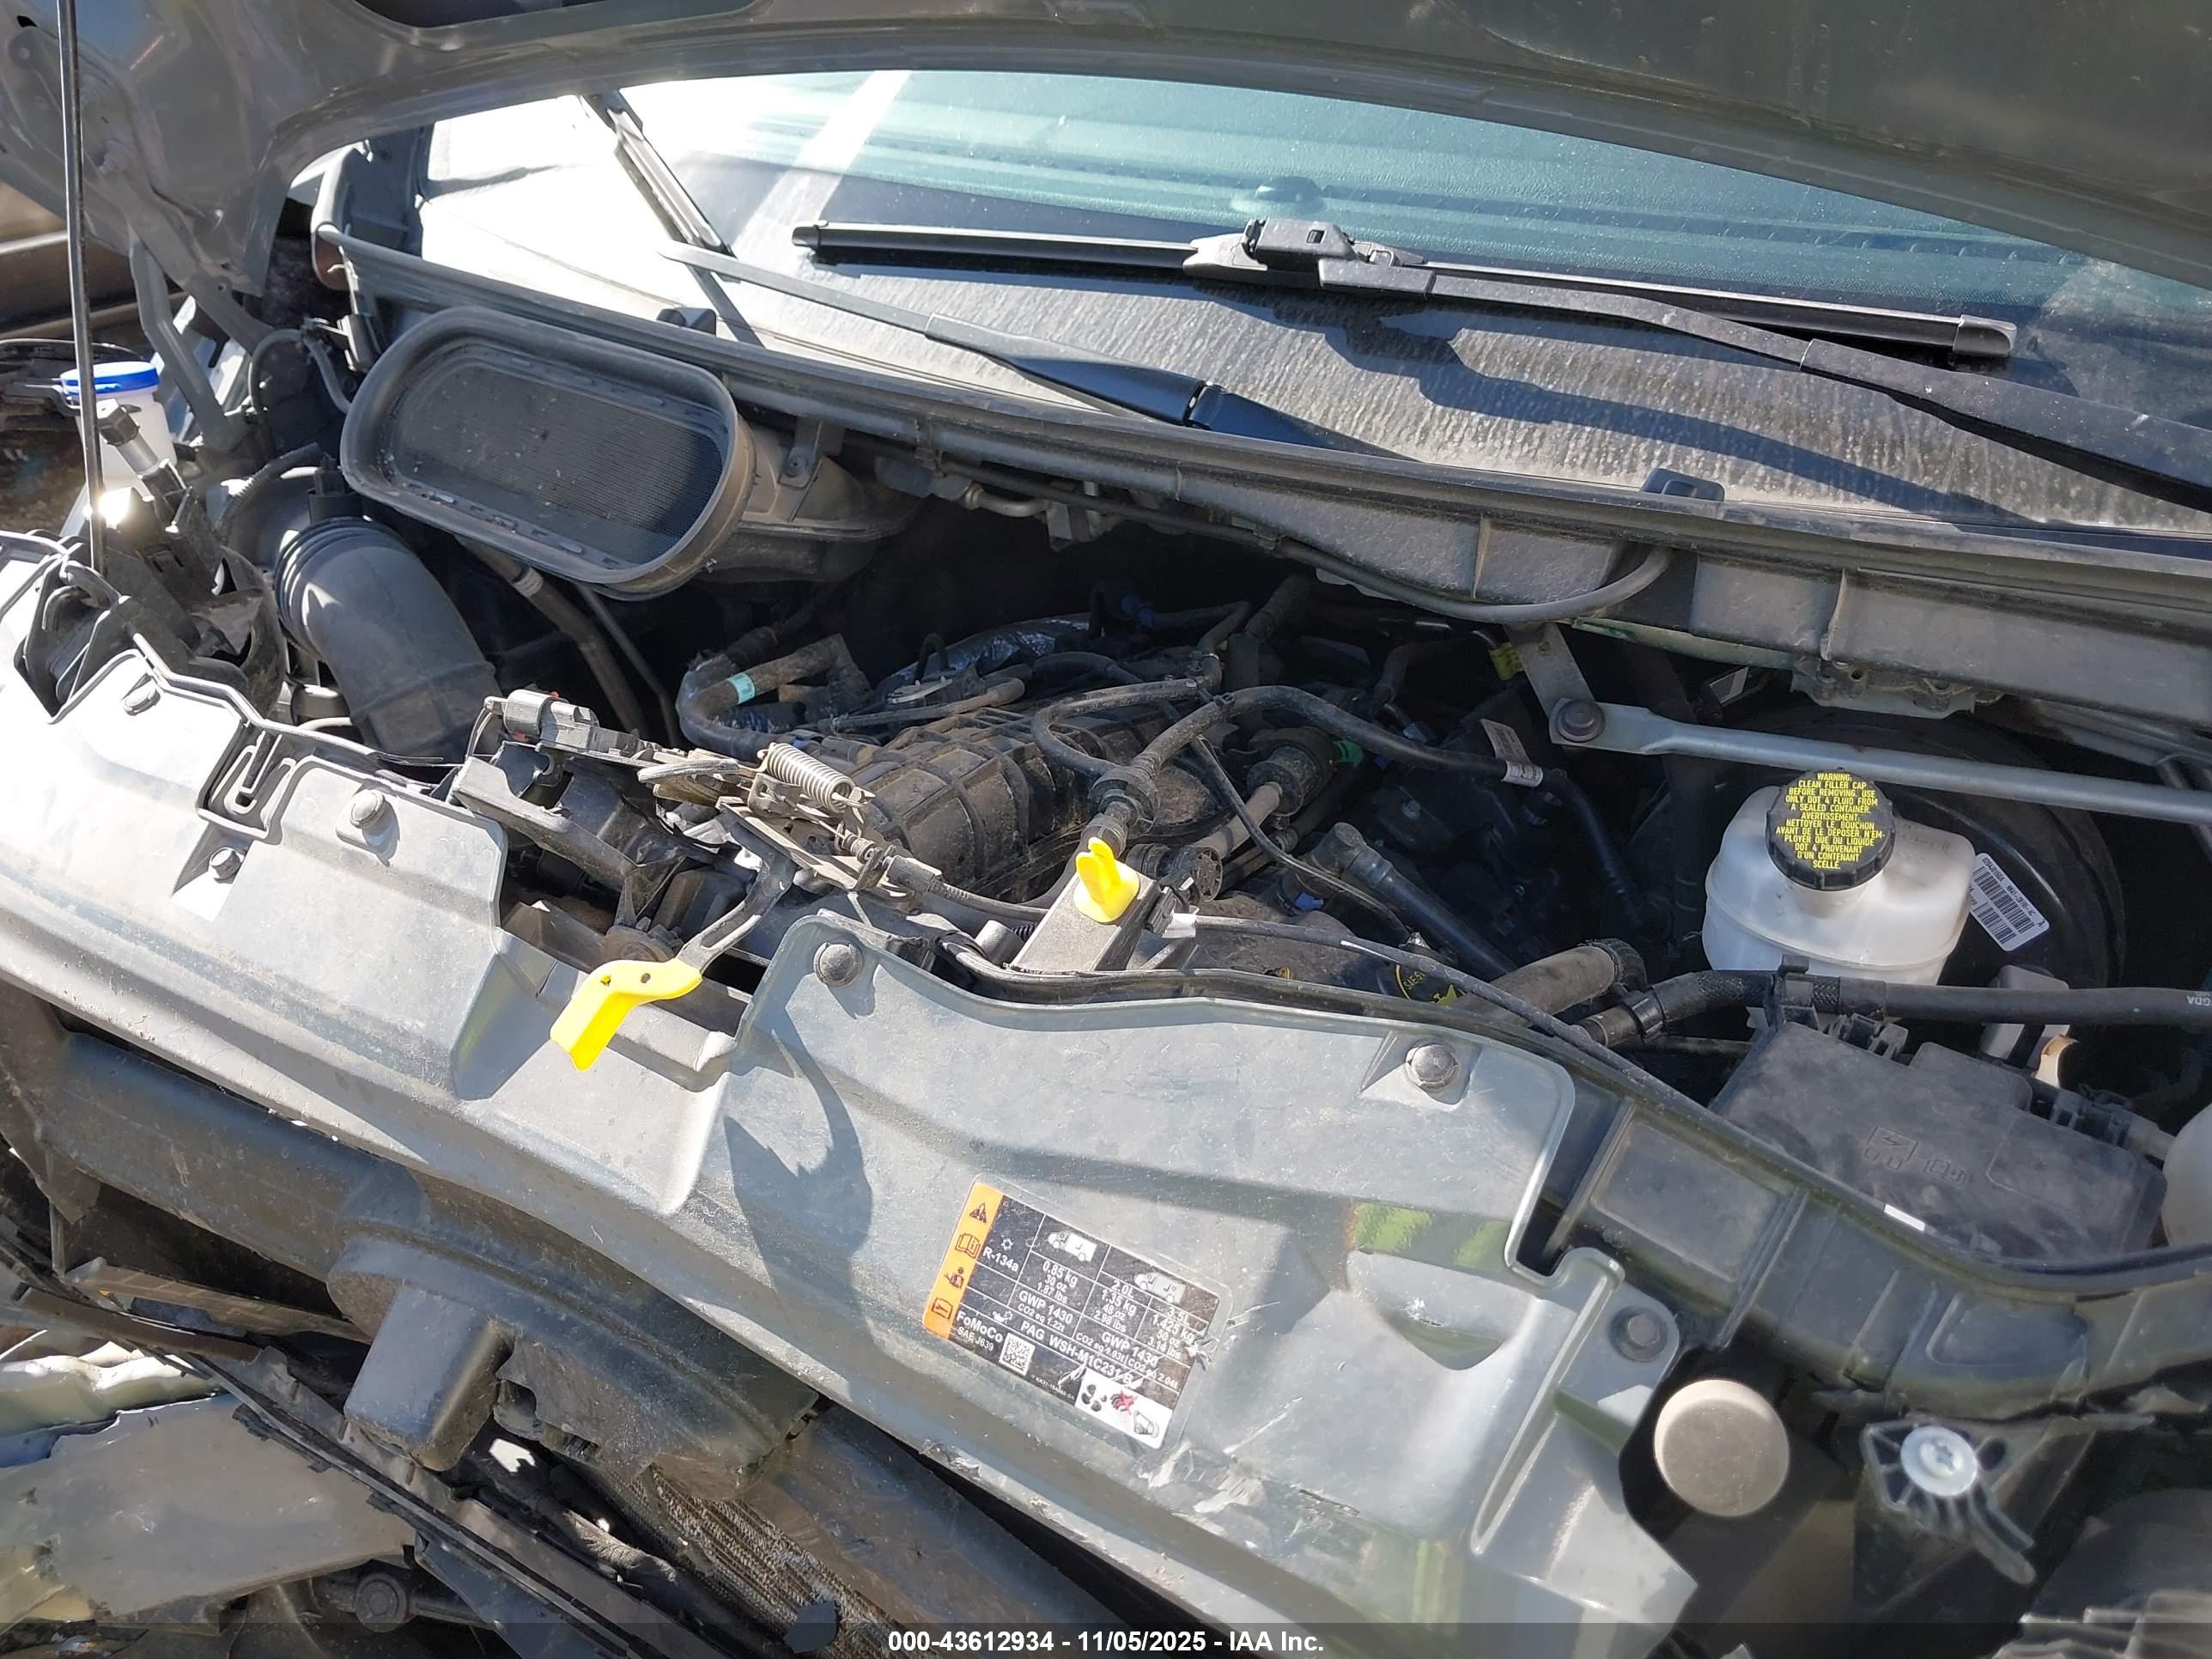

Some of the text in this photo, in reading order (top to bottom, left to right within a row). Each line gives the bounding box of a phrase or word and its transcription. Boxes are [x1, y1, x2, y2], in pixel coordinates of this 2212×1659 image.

[1798, 780, 1867, 790] CLEAN FILLER CAP
[1818, 773, 1852, 781] WARNING:
[1786, 794, 1804, 803] ONLY
[1808, 796, 1821, 805] DOT
[1833, 797, 1854, 805] FLUID
[1820, 788, 1856, 799] REMOVING.
[1862, 790, 1875, 799] USE
[1800, 803, 1826, 811] SEALED
[1830, 804, 1871, 813] CONTAINER.
[1802, 811, 1860, 822] AVERTISSEMENT:
[1776, 826, 1799, 835] AVANT
[1802, 827, 1812, 836] DE
[1864, 830, 1885, 839] N'EM-
[1786, 819, 1822, 829] NETTOYER
[1841, 821, 1875, 830] BOUCHON
[1784, 834, 1811, 843] PLOYER
[1815, 836, 1829, 844] QUE
[1847, 837, 1875, 846] LIQUIDE
[1795, 842, 1808, 851] DOT
[1820, 843, 1863, 854] PROVENANT
[1797, 851, 1859, 861] D'UN CONTENANT
[1403, 975, 1415, 989] SAE
[982, 1246, 1018, 1272] R-134a
[1042, 1260, 1081, 1288] 0.85 kg
[1045, 1274, 1067, 1292] 30 oz
[1037, 1282, 1067, 1304] 1.87 lbs
[1111, 1279, 1133, 1299] 2.0L
[1019, 1291, 1073, 1324] GWP 1430
[1102, 1289, 1137, 1317] 1.35 kg
[1103, 1304, 1126, 1321] 48 oz
[1018, 1304, 1065, 1333] CO2 eq 1.22t
[1093, 1310, 1127, 1333] 2.98 lbs
[1166, 1306, 1189, 1326] 3.5L
[957, 1310, 1003, 1342] FoMoCo
[1021, 1321, 1045, 1340] PAG
[1153, 1314, 1195, 1346] 1.425 kg
[957, 1327, 994, 1351] SAE J639
[1076, 1333, 1125, 1362] CO2 eq 1.93t
[1147, 1336, 1181, 1359] 3.14 lbs
[1157, 1329, 1181, 1348] 50 oz
[1102, 1332, 1160, 1367] GWP 1430
[1128, 1358, 1146, 1372] CO2
